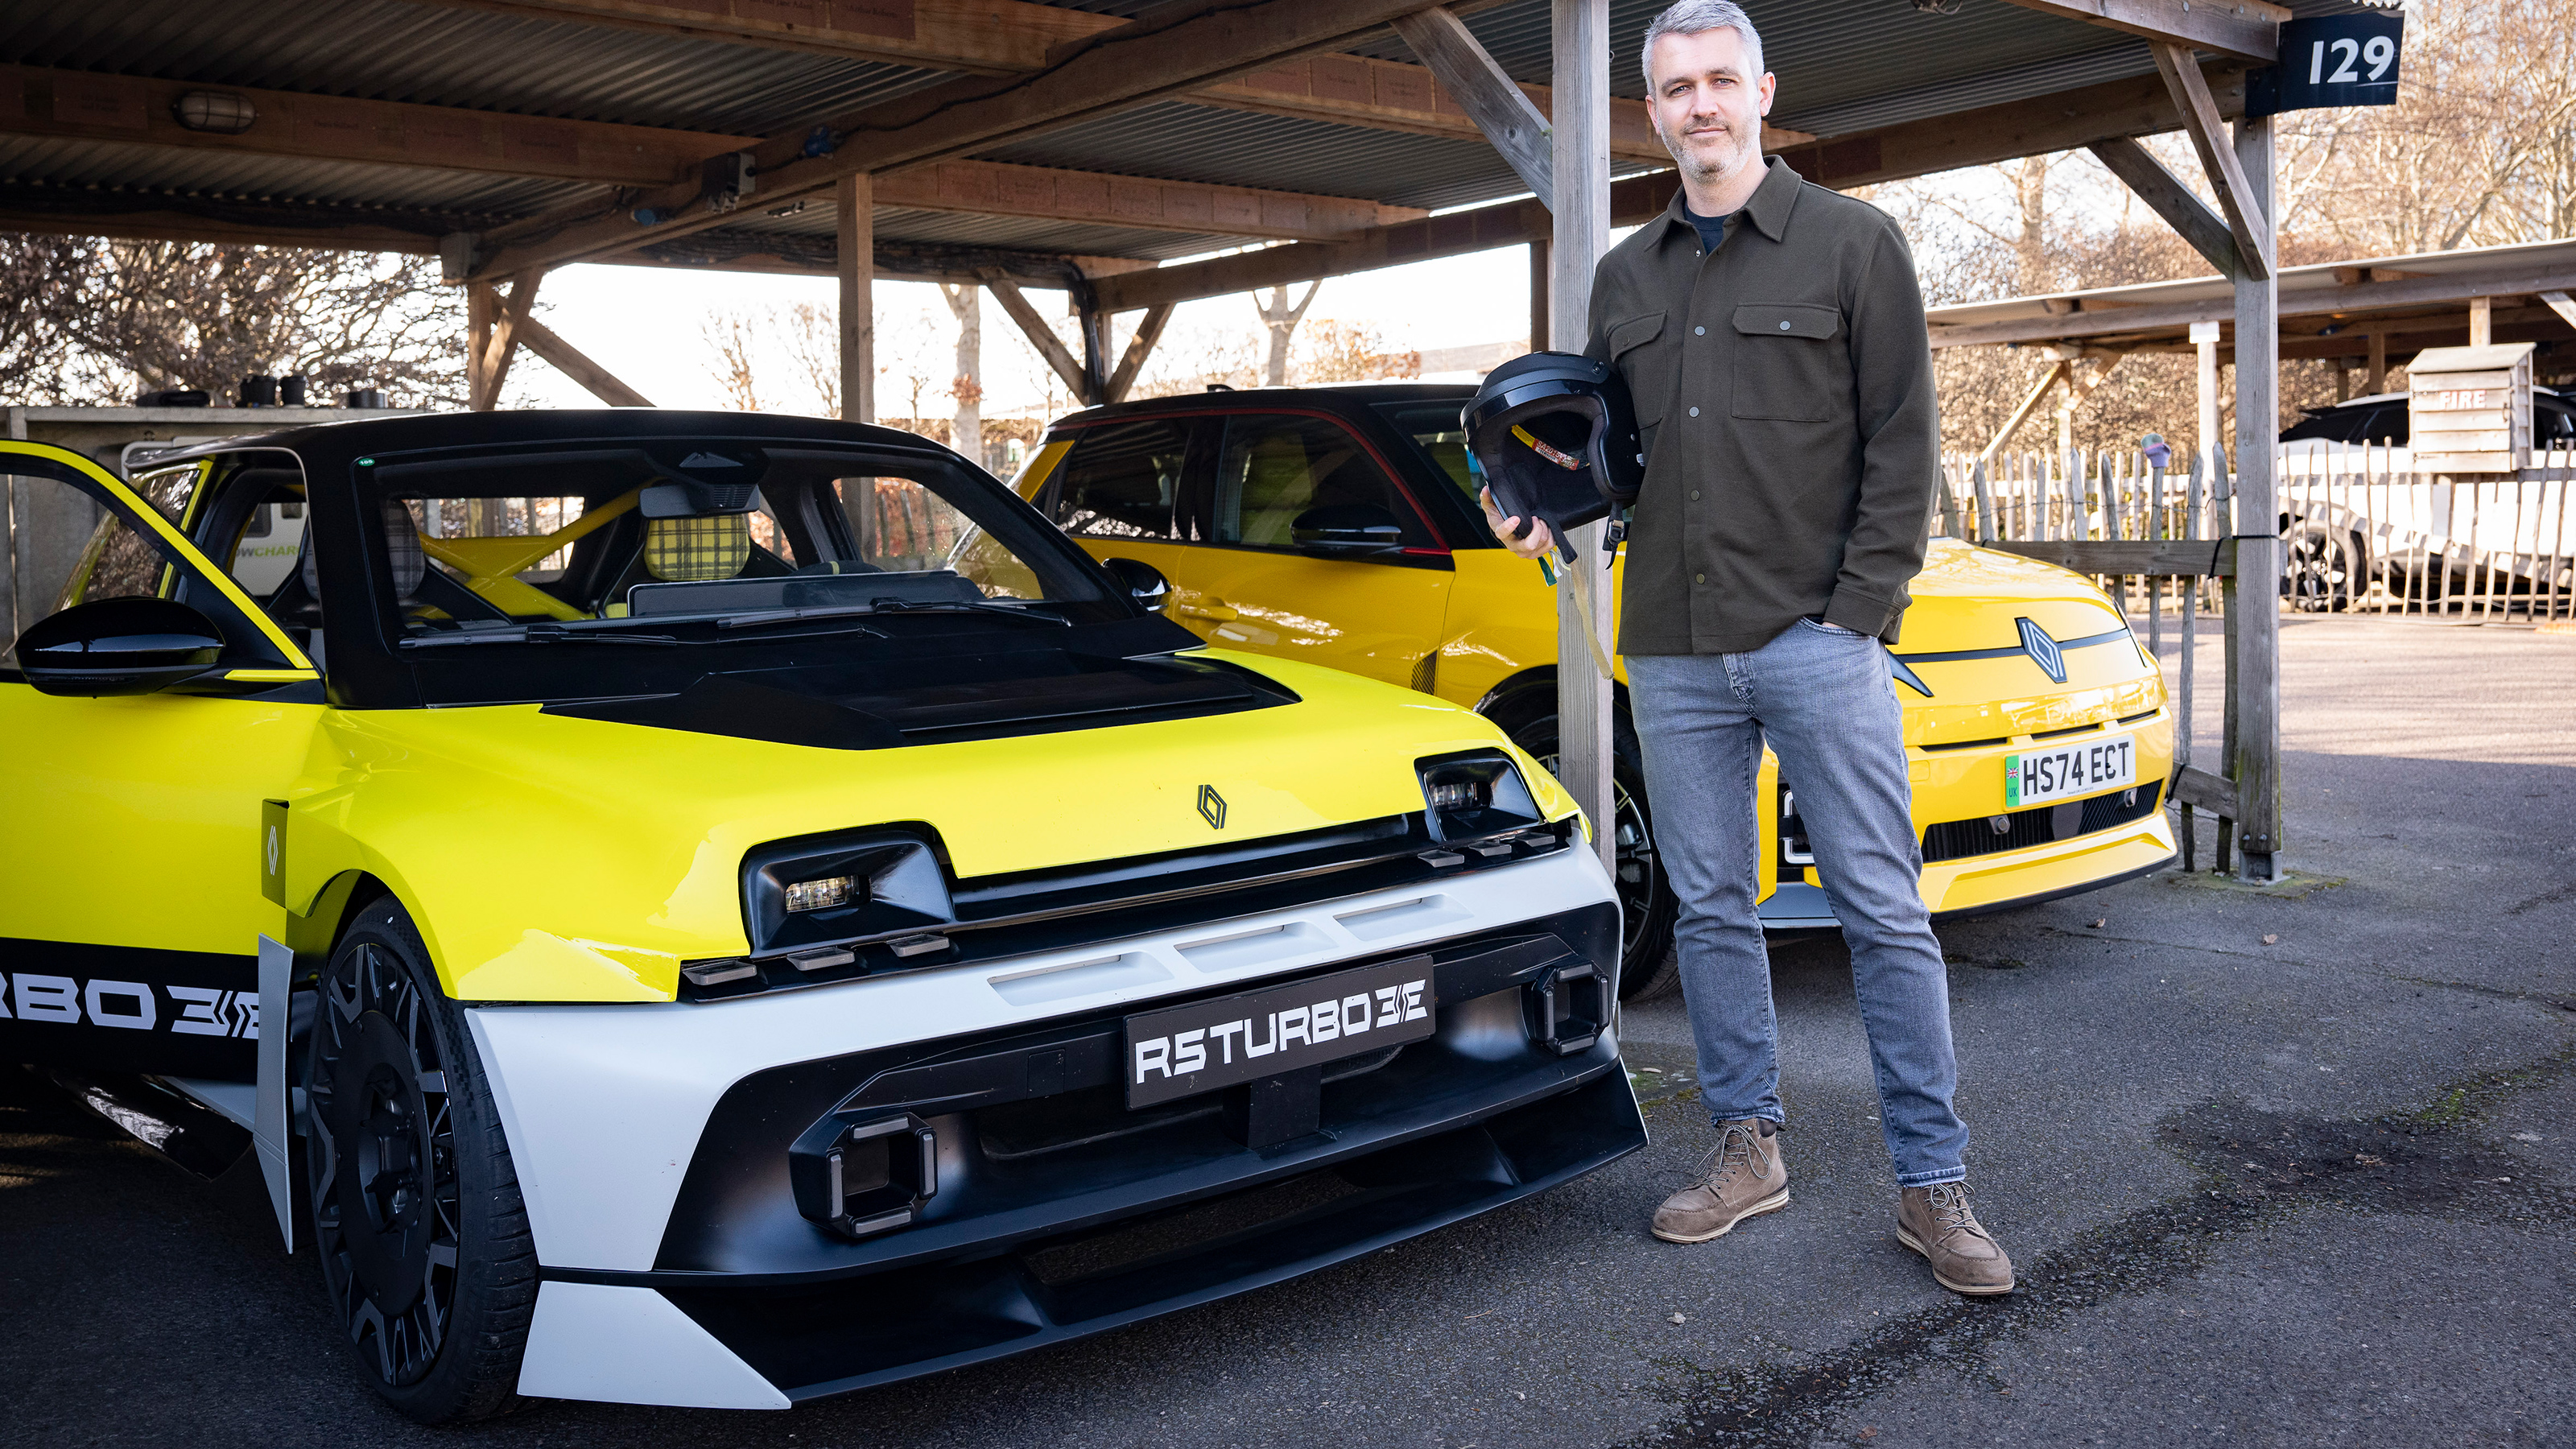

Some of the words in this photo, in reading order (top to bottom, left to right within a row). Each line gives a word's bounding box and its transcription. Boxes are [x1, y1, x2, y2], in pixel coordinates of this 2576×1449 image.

[2309, 35, 2395, 85] 129
[2439, 390, 2487, 410] FIRE
[2023, 751, 2084, 796] HS74
[2091, 741, 2129, 783] ECT
[2008, 786, 2017, 798] UK
